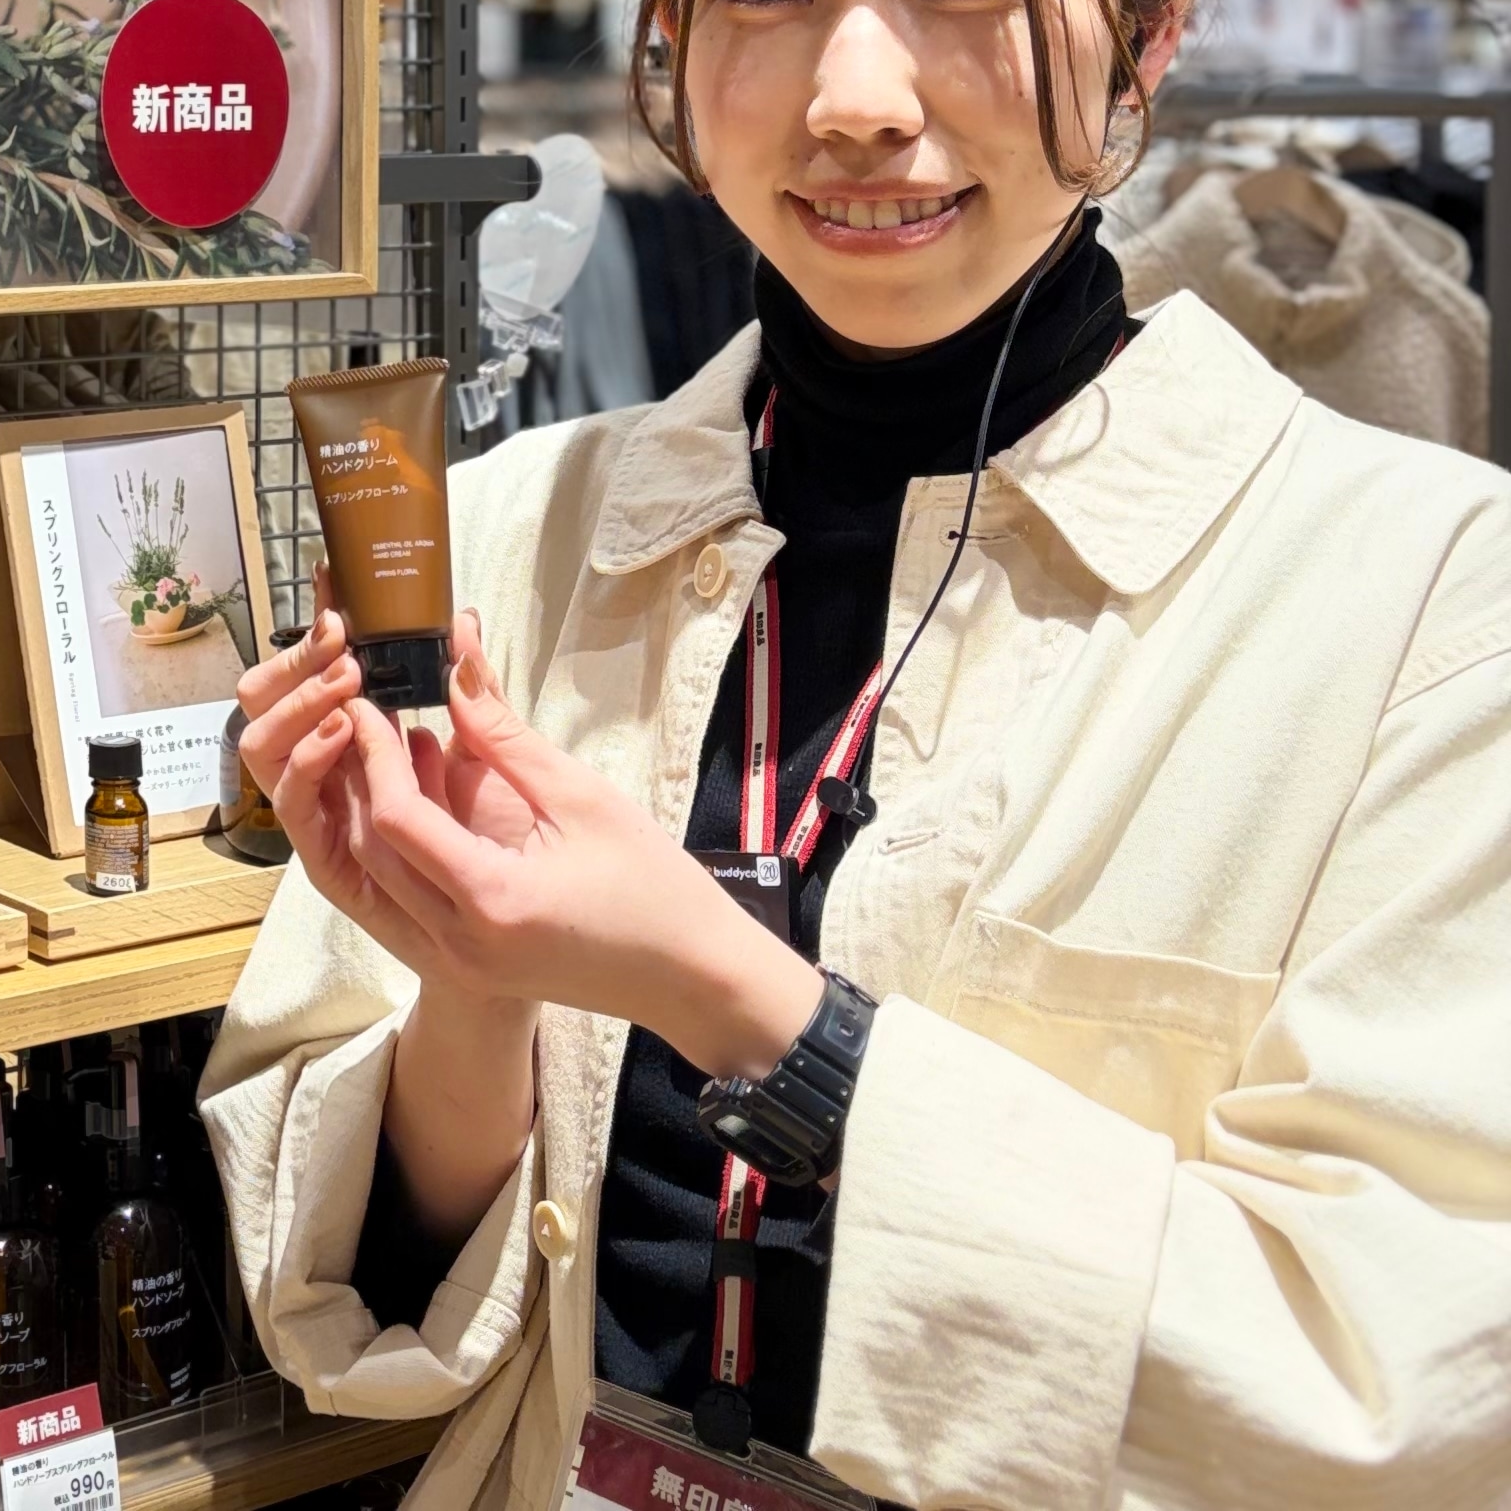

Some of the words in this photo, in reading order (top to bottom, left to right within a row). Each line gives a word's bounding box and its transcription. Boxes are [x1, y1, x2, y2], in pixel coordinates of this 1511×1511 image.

[131, 82, 254, 134] 新商品
[319, 437, 381, 459] 精油の香り
[320, 453, 399, 476] ハンドクリーム
[324, 484, 409, 506] スプリングフローラル
[41, 498, 78, 666] スプリングフローラル
[131, 1267, 183, 1292] 精油の香り
[131, 1282, 185, 1309] ハンドソープ
[16, 1405, 82, 1446] 新商品
[11, 1457, 49, 1477] 精油の香り
[13, 1451, 115, 1488] ハンドソープスプリングフローラル
[54, 1494, 70, 1506] 税込
[70, 1471, 115, 1499] 990円
